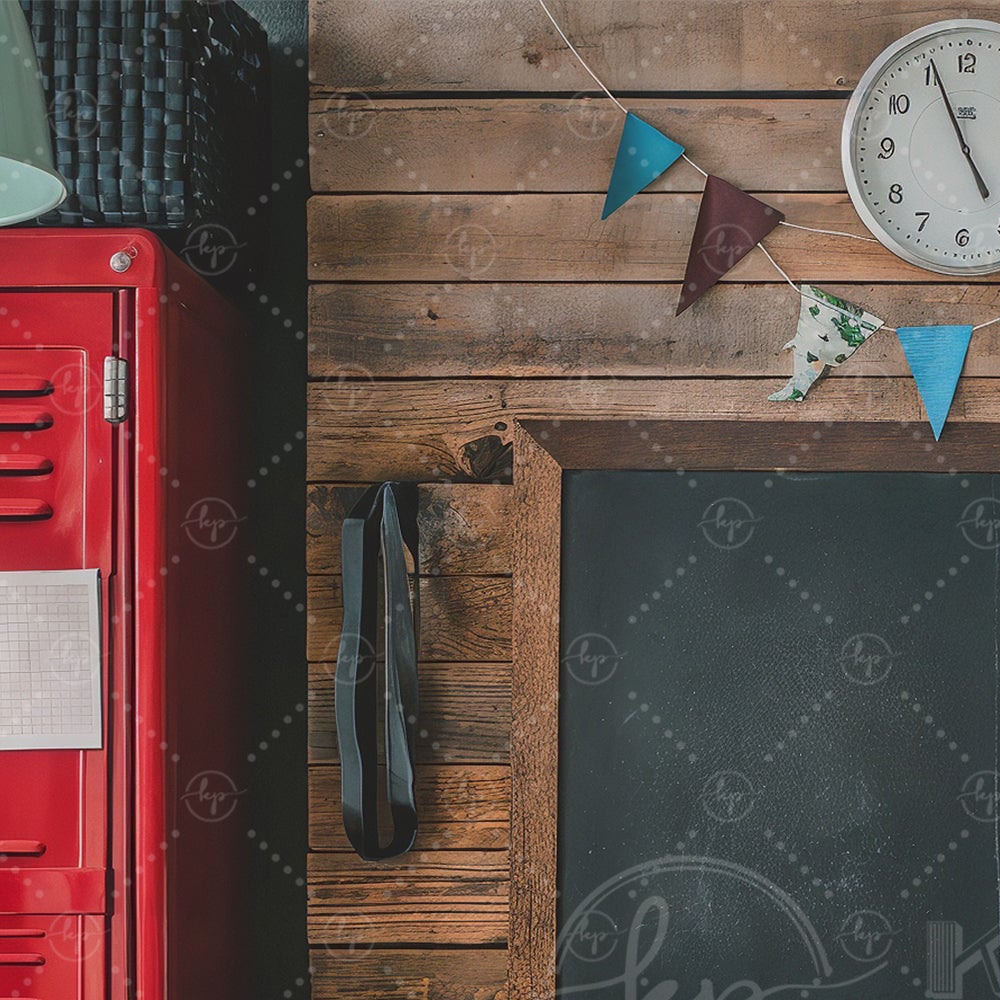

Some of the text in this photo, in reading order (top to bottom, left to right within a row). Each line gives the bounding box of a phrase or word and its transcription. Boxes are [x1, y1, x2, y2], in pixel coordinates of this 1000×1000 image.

[958, 53, 977, 73] 12
[924, 64, 939, 86] 11
[888, 94, 911, 115] 10
[877, 137, 895, 160] 9
[888, 184, 903, 204] 8
[914, 212, 930, 232] 7
[955, 229, 970, 247] 6
